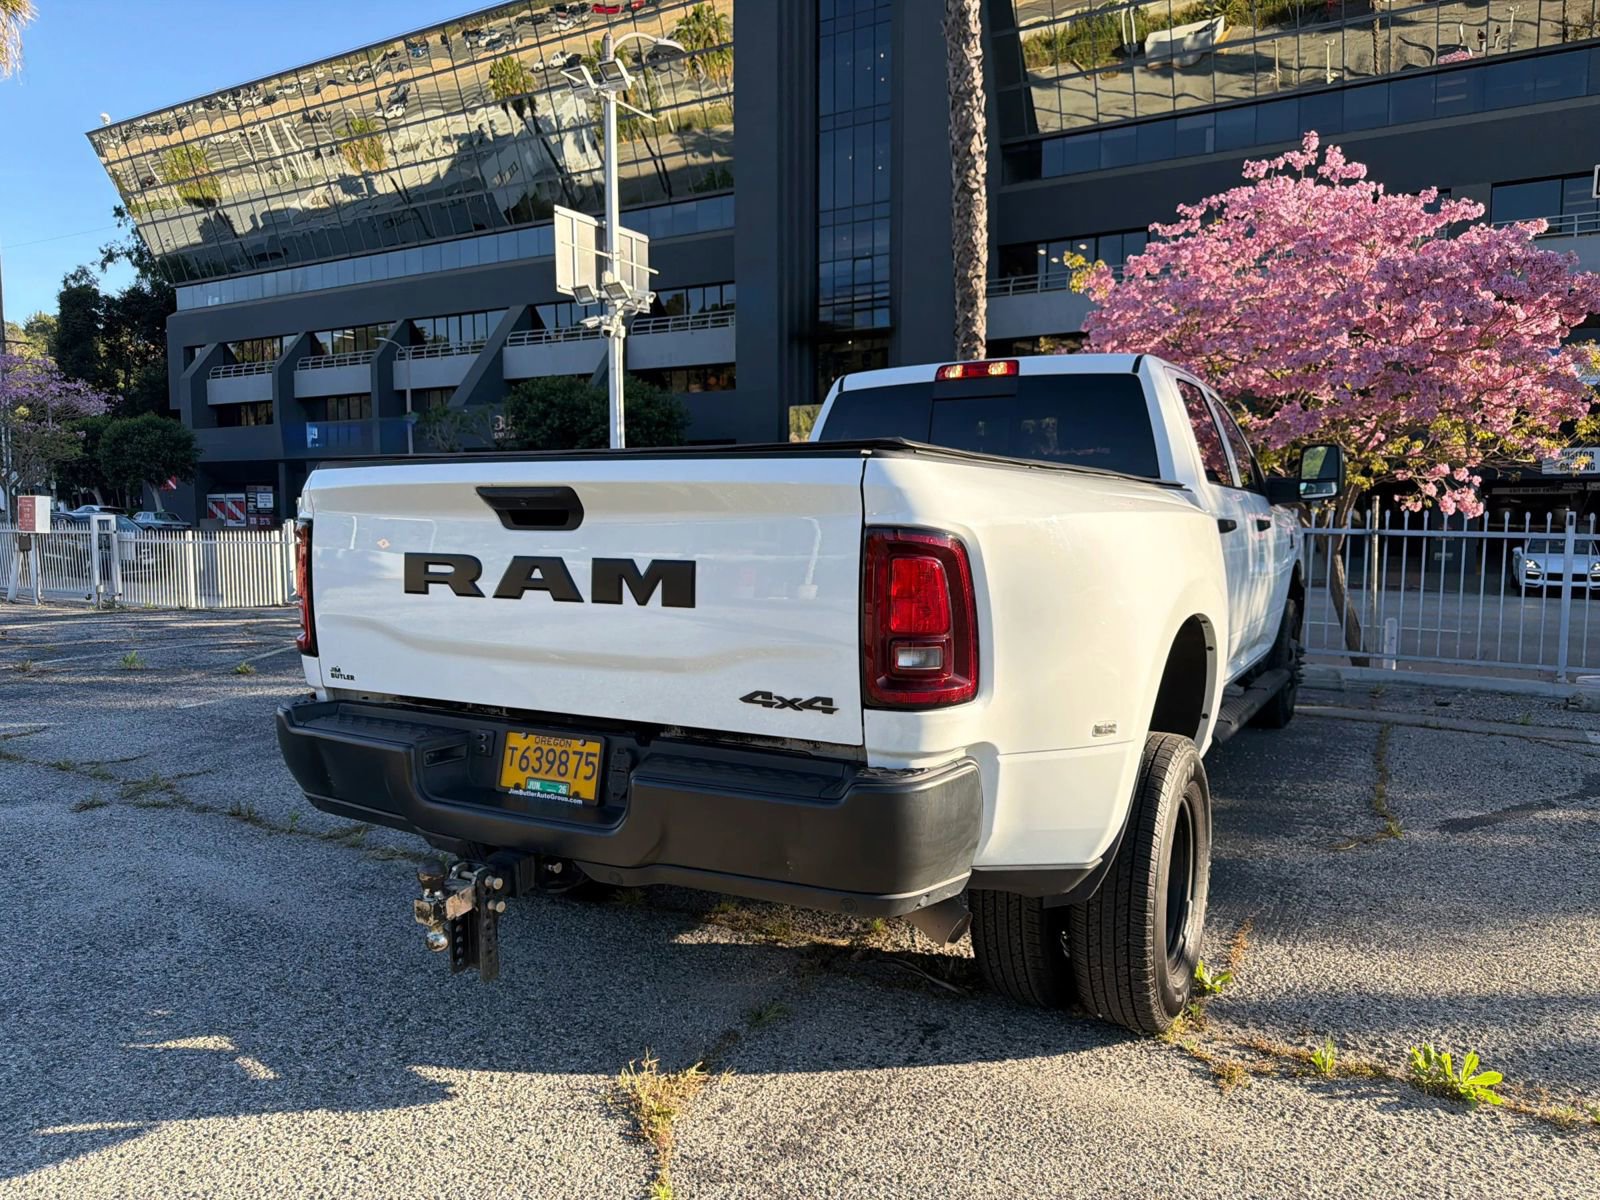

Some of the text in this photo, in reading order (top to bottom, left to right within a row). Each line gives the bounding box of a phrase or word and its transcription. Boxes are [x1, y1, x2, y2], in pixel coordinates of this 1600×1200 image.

[404, 552, 697, 608] RAM
[330, 672, 355, 681] BUTLER
[534, 737, 572, 748] OREGON
[508, 746, 597, 780] T639875
